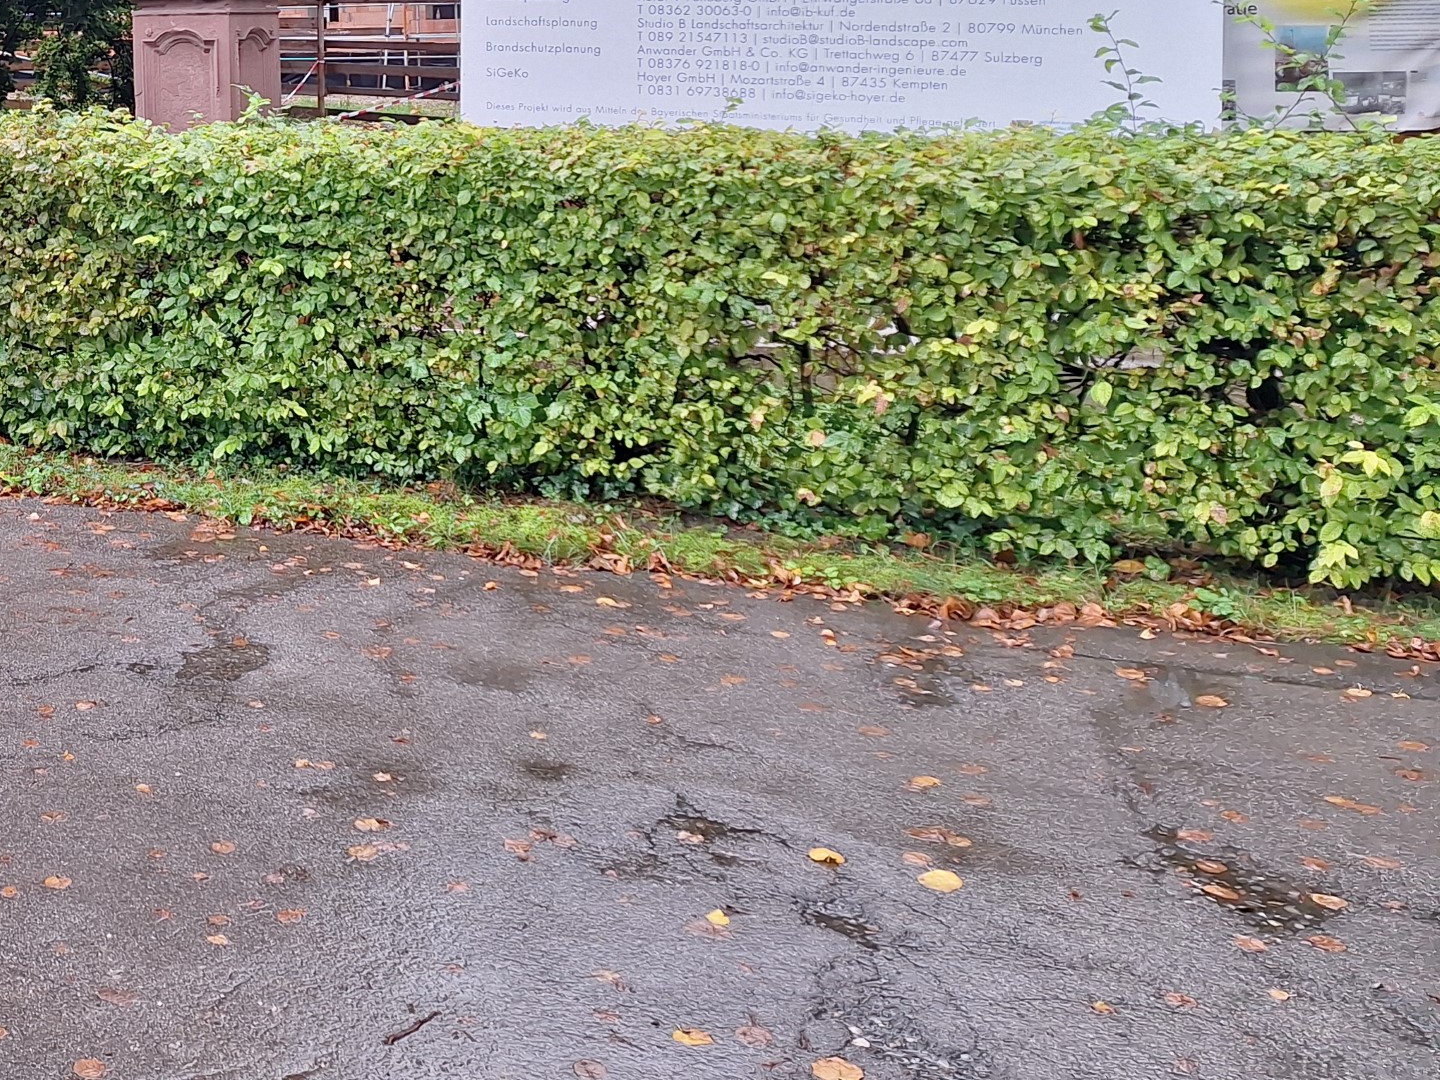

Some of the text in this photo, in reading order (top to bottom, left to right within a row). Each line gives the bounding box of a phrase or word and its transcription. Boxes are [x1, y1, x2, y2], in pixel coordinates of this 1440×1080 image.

[636, 4, 644, 14] T
[647, 4, 691, 15] 08362
[696, 5, 752, 16] 30063-0
[485, 14, 598, 30] Landschaftsplanung
[636, 16, 674, 28] Studio
[691, 17, 824, 30] Landschaftsarchitektur
[838, 19, 936, 32] Nordendstraße
[941, 21, 951, 32] 2
[967, 22, 1016, 33] 80799
[1021, 21, 1083, 34] München
[637, 31, 643, 41] T
[647, 31, 674, 42] 089
[678, 31, 748, 43] 21547113
[485, 40, 601, 56] Brandschutzplanung
[636, 43, 697, 55] Anwander
[701, 44, 741, 56] GmbH
[759, 46, 782, 57] Co.
[788, 47, 808, 58] KG
[823, 46, 900, 63] Trettachweg
[905, 49, 915, 60] 6
[931, 50, 979, 61] 87477
[983, 49, 1043, 66] Sulzberg
[636, 57, 643, 68] T
[647, 58, 691, 69] 08376
[695, 59, 760, 70] 921818-0
[485, 67, 529, 78] SiGeKo
[636, 70, 948, 92] Hoyer GmbH Mozartstraße 4 87435 Kempten
[636, 84, 643, 94] T
[647, 84, 679, 95] 0831
[686, 85, 756, 98] 69738688
[486, 101, 515, 111] Dieses
[518, 102, 549, 114] Projekt
[551, 103, 572, 113] wird
[594, 104, 627, 114] Mitteln
[650, 106, 709, 120] Bayerischen
[805, 112, 819, 121] für
[886, 114, 906, 124] und
